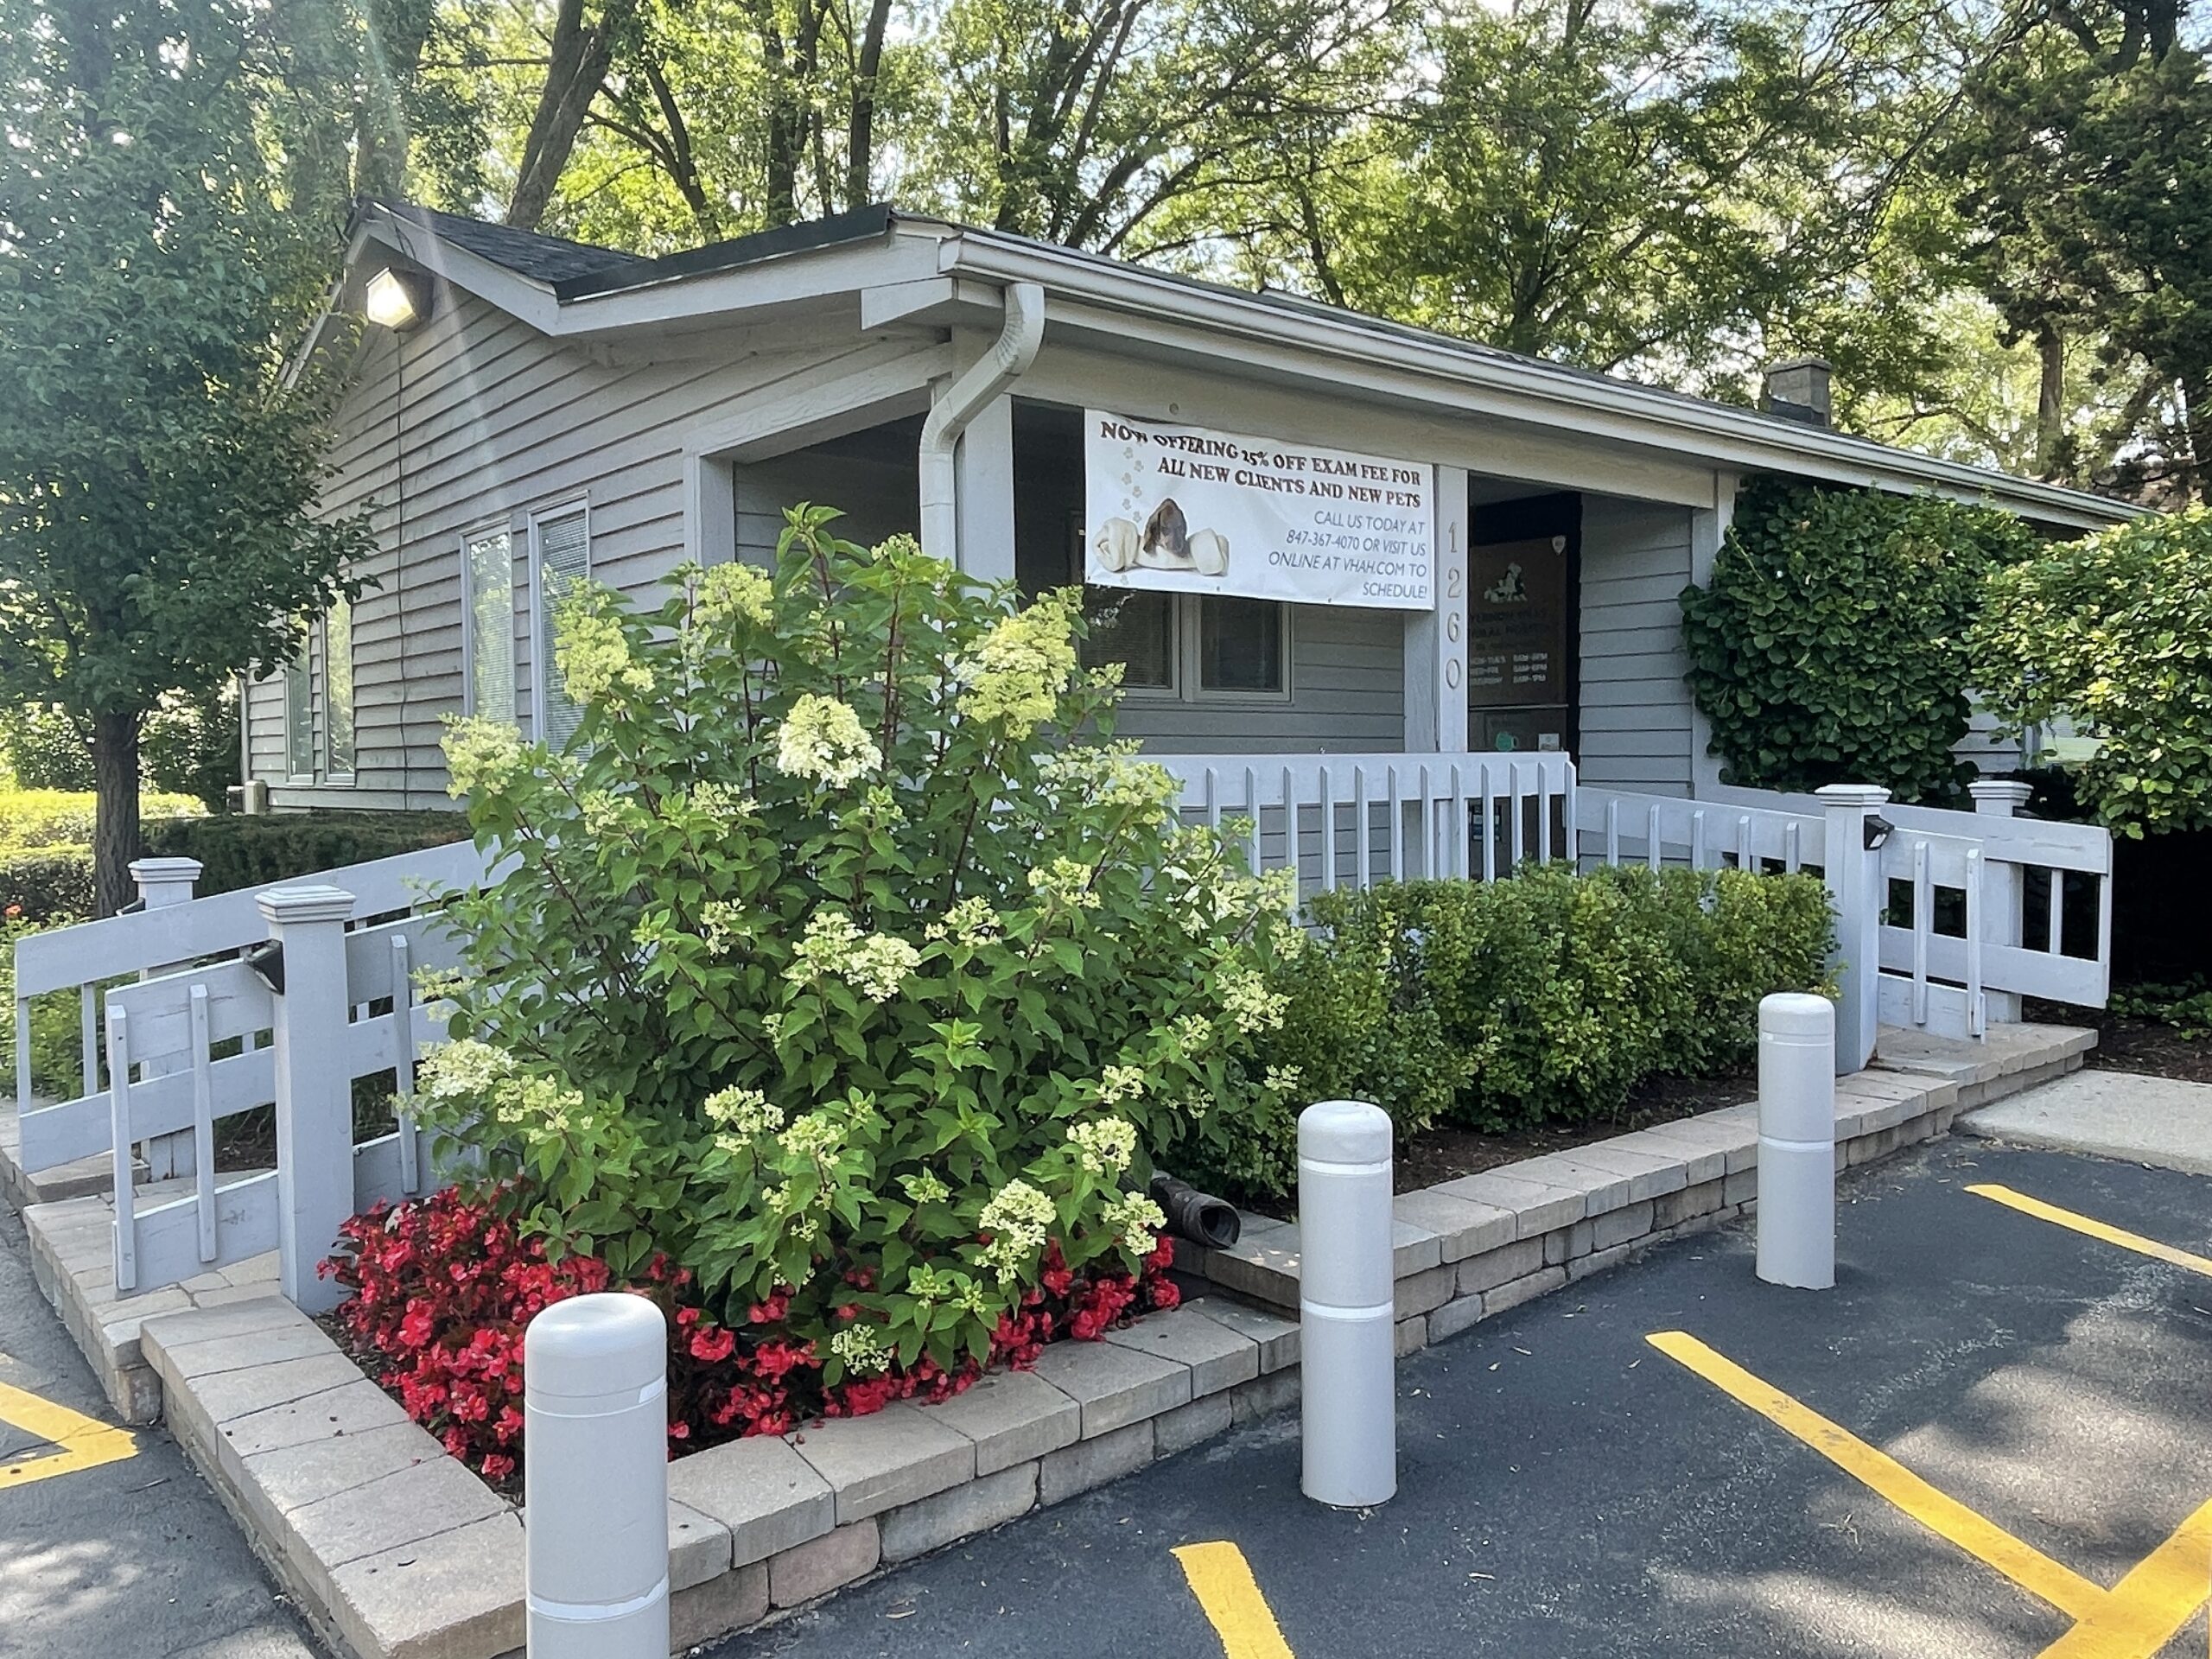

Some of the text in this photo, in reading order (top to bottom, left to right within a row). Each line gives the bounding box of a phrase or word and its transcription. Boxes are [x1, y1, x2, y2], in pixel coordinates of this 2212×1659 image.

[1101, 422, 1147, 443] NOW
[1154, 435, 1238, 460] OFFERING
[1274, 454, 1307, 471] OFF
[1312, 457, 1357, 478] EXAM
[1361, 464, 1389, 482] FEE
[1392, 467, 1421, 486] FOR
[1157, 457, 1421, 508] ALL NEW CLIENTS AND NEW PETS
[1314, 511, 1426, 536] CALL US TODAY AT
[1286, 529, 1427, 556] 847-367-4070 OR VISIT US
[1268, 550, 1427, 578] ONLINE AT VHAH.COM TO
[1363, 582, 1427, 600] SCHEDULE!
